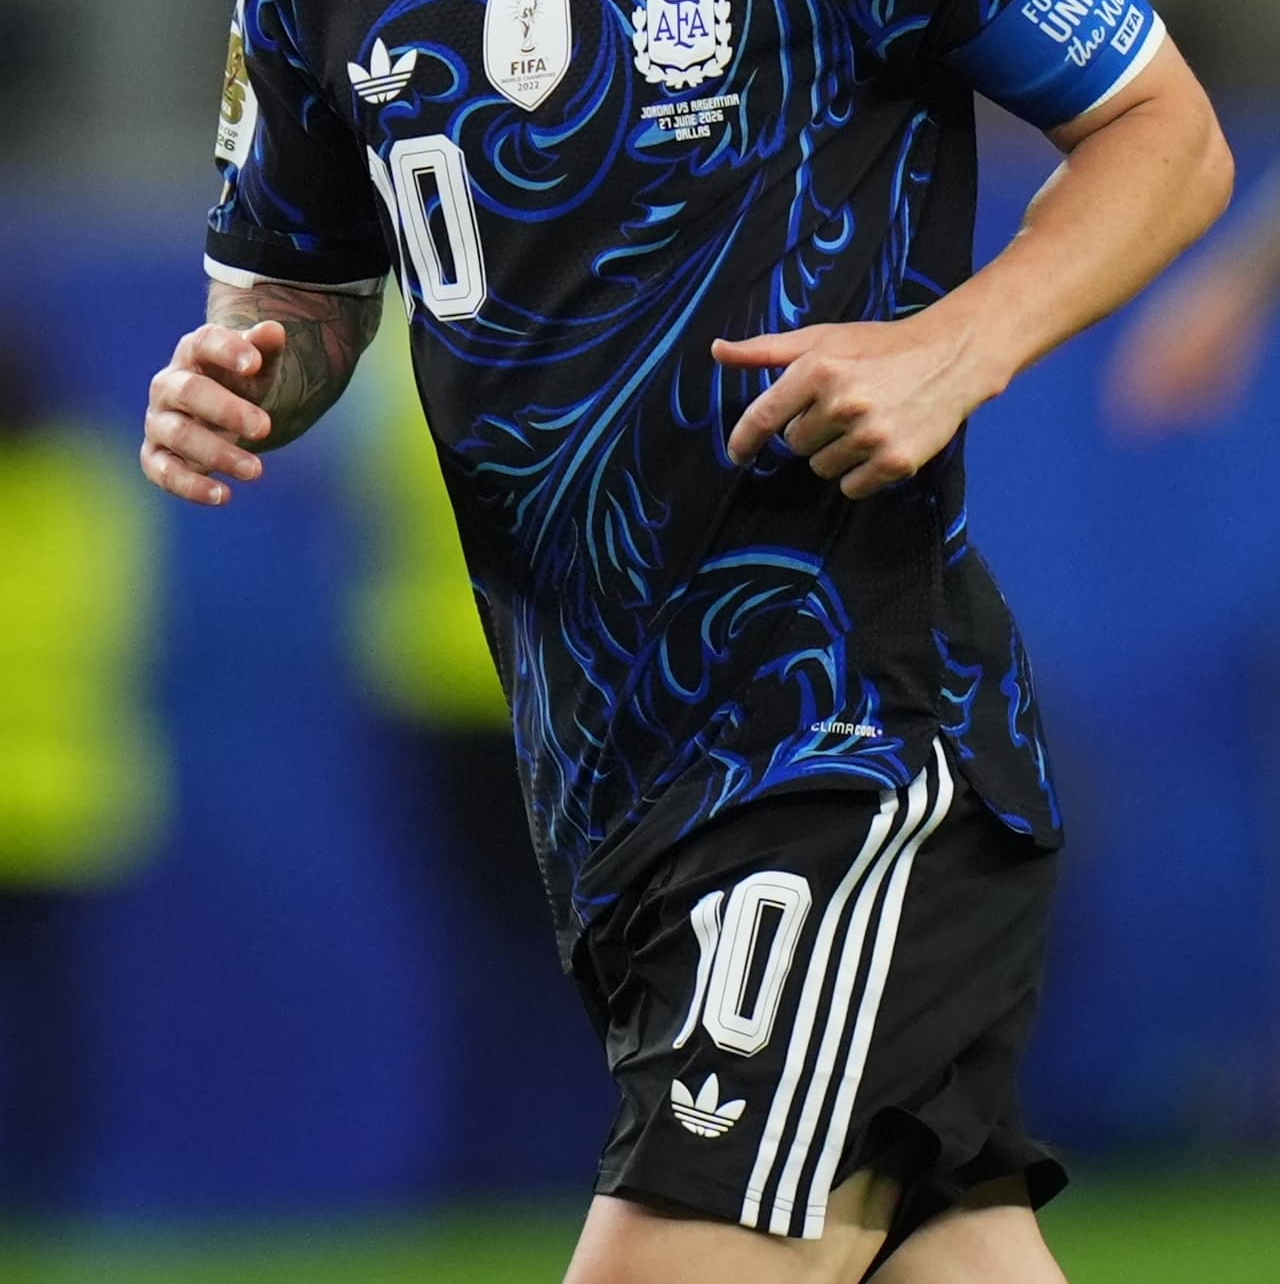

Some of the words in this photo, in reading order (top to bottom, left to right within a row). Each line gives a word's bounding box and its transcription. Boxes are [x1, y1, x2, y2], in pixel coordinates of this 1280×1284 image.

[1116, 9, 1144, 53] FIFA
[1064, 26, 1106, 67] the
[510, 58, 546, 76] FIFA
[517, 81, 540, 92] 2022
[641, 103, 675, 119] JORDAN
[676, 101, 689, 114] VS
[690, 93, 740, 112] ARGENTINA
[659, 116, 672, 129] 27
[673, 113, 698, 128] JUNE
[698, 110, 724, 125] 2026
[676, 125, 711, 141] DALLAS
[673, 870, 812, 1058] 10
